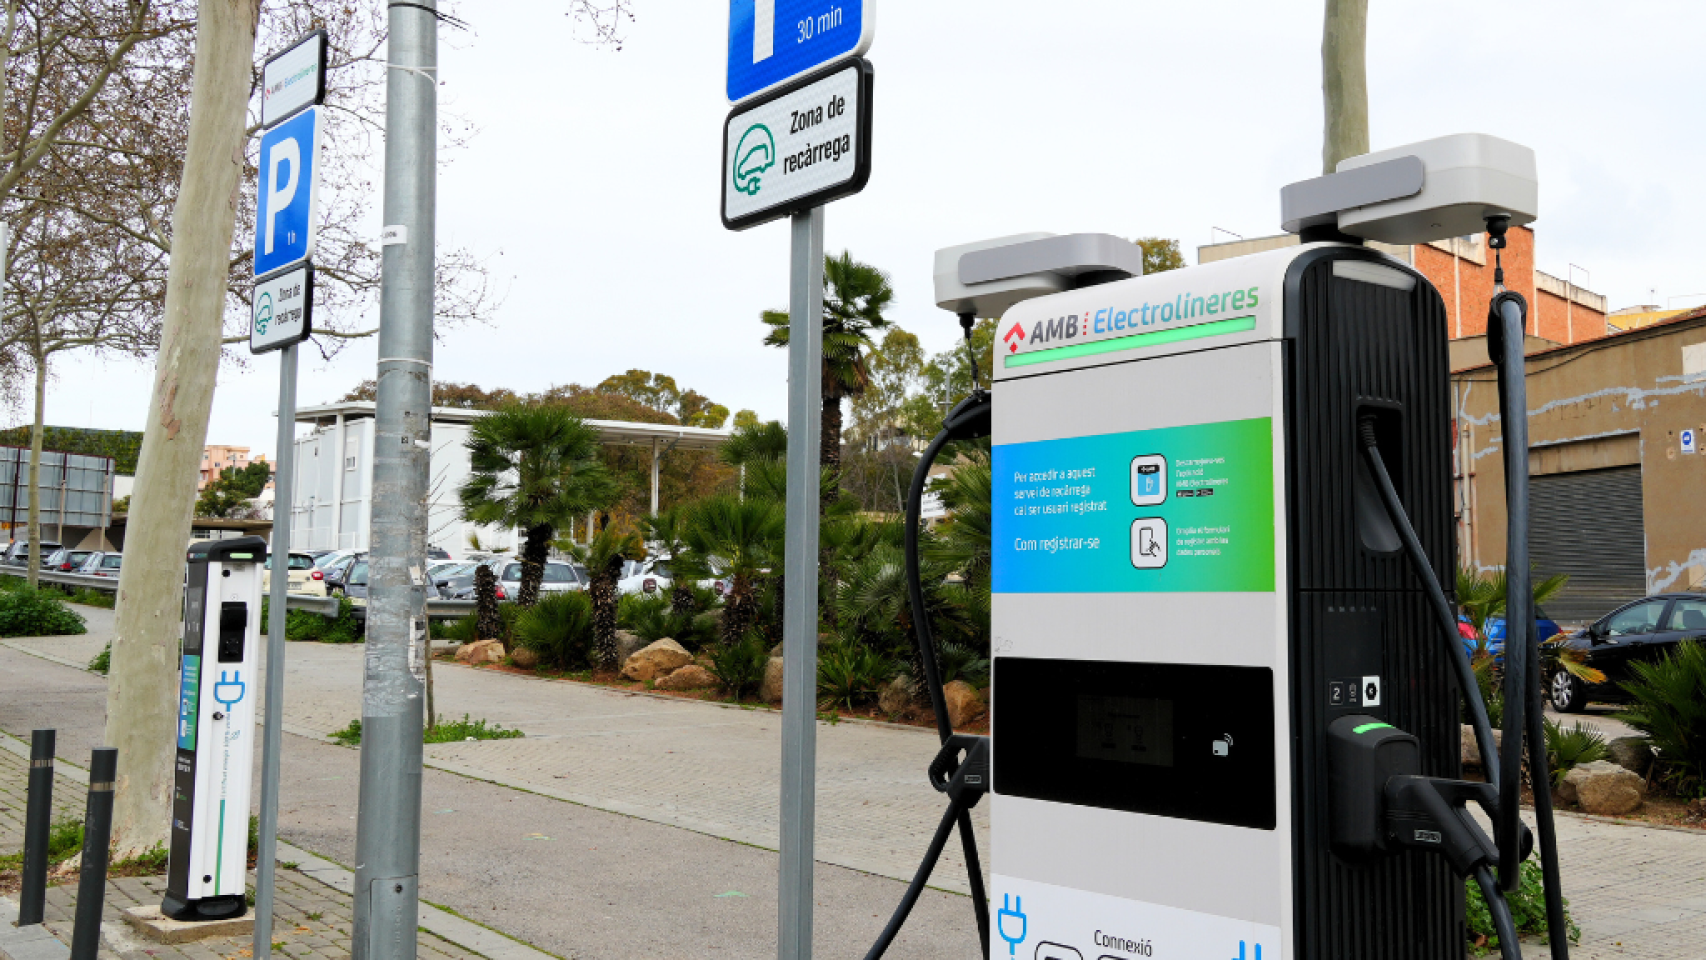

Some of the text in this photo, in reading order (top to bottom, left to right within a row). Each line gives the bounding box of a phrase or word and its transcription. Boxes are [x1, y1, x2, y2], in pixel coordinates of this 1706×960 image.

[797, 16, 814, 44] 30
[817, 5, 842, 35] min
[789, 94, 845, 135] Zona de
[782, 134, 850, 175] recàrrega
[264, 136, 301, 256] P
[1029, 286, 1260, 345] AMB Electrolineres
[1014, 466, 1096, 483] Per accedir a aquest
[1014, 484, 1091, 499] servei de recàrrega
[1014, 500, 1107, 516] cal ser usuari registrat
[1014, 535, 1100, 554] Com registrar-se
[1332, 686, 1341, 701] 2
[1094, 929, 1153, 957] Connexió
